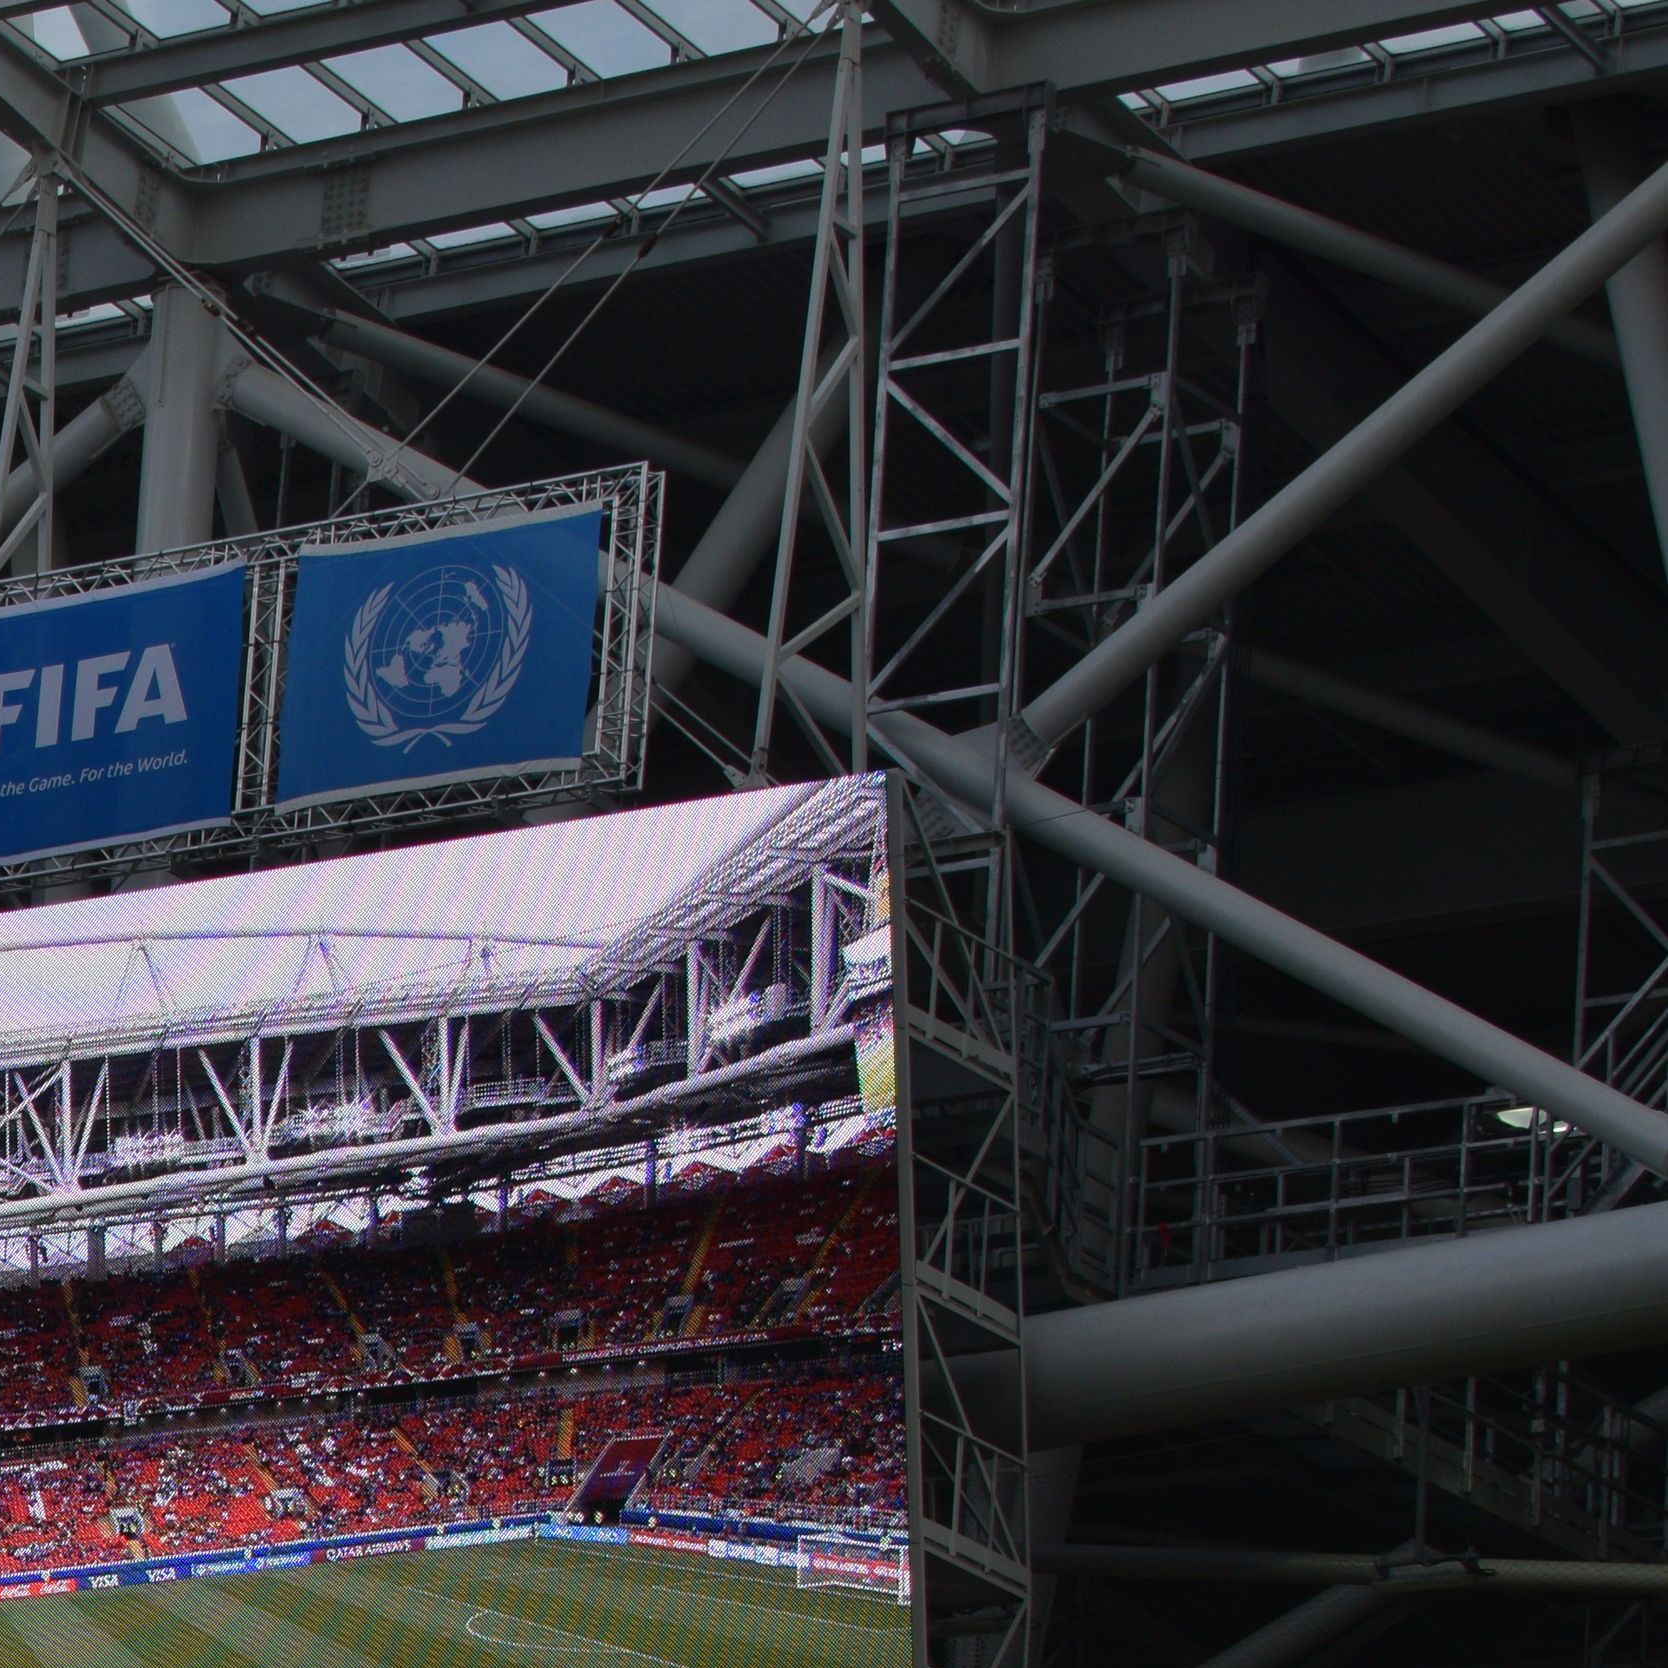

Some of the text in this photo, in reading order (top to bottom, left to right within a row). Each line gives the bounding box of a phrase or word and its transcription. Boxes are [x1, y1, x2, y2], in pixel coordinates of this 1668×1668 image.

[0, 781, 24, 797] the
[28, 774, 75, 793] Game.
[80, 766, 106, 783] For
[107, 762, 133, 778] the
[138, 749, 188, 773] World.
